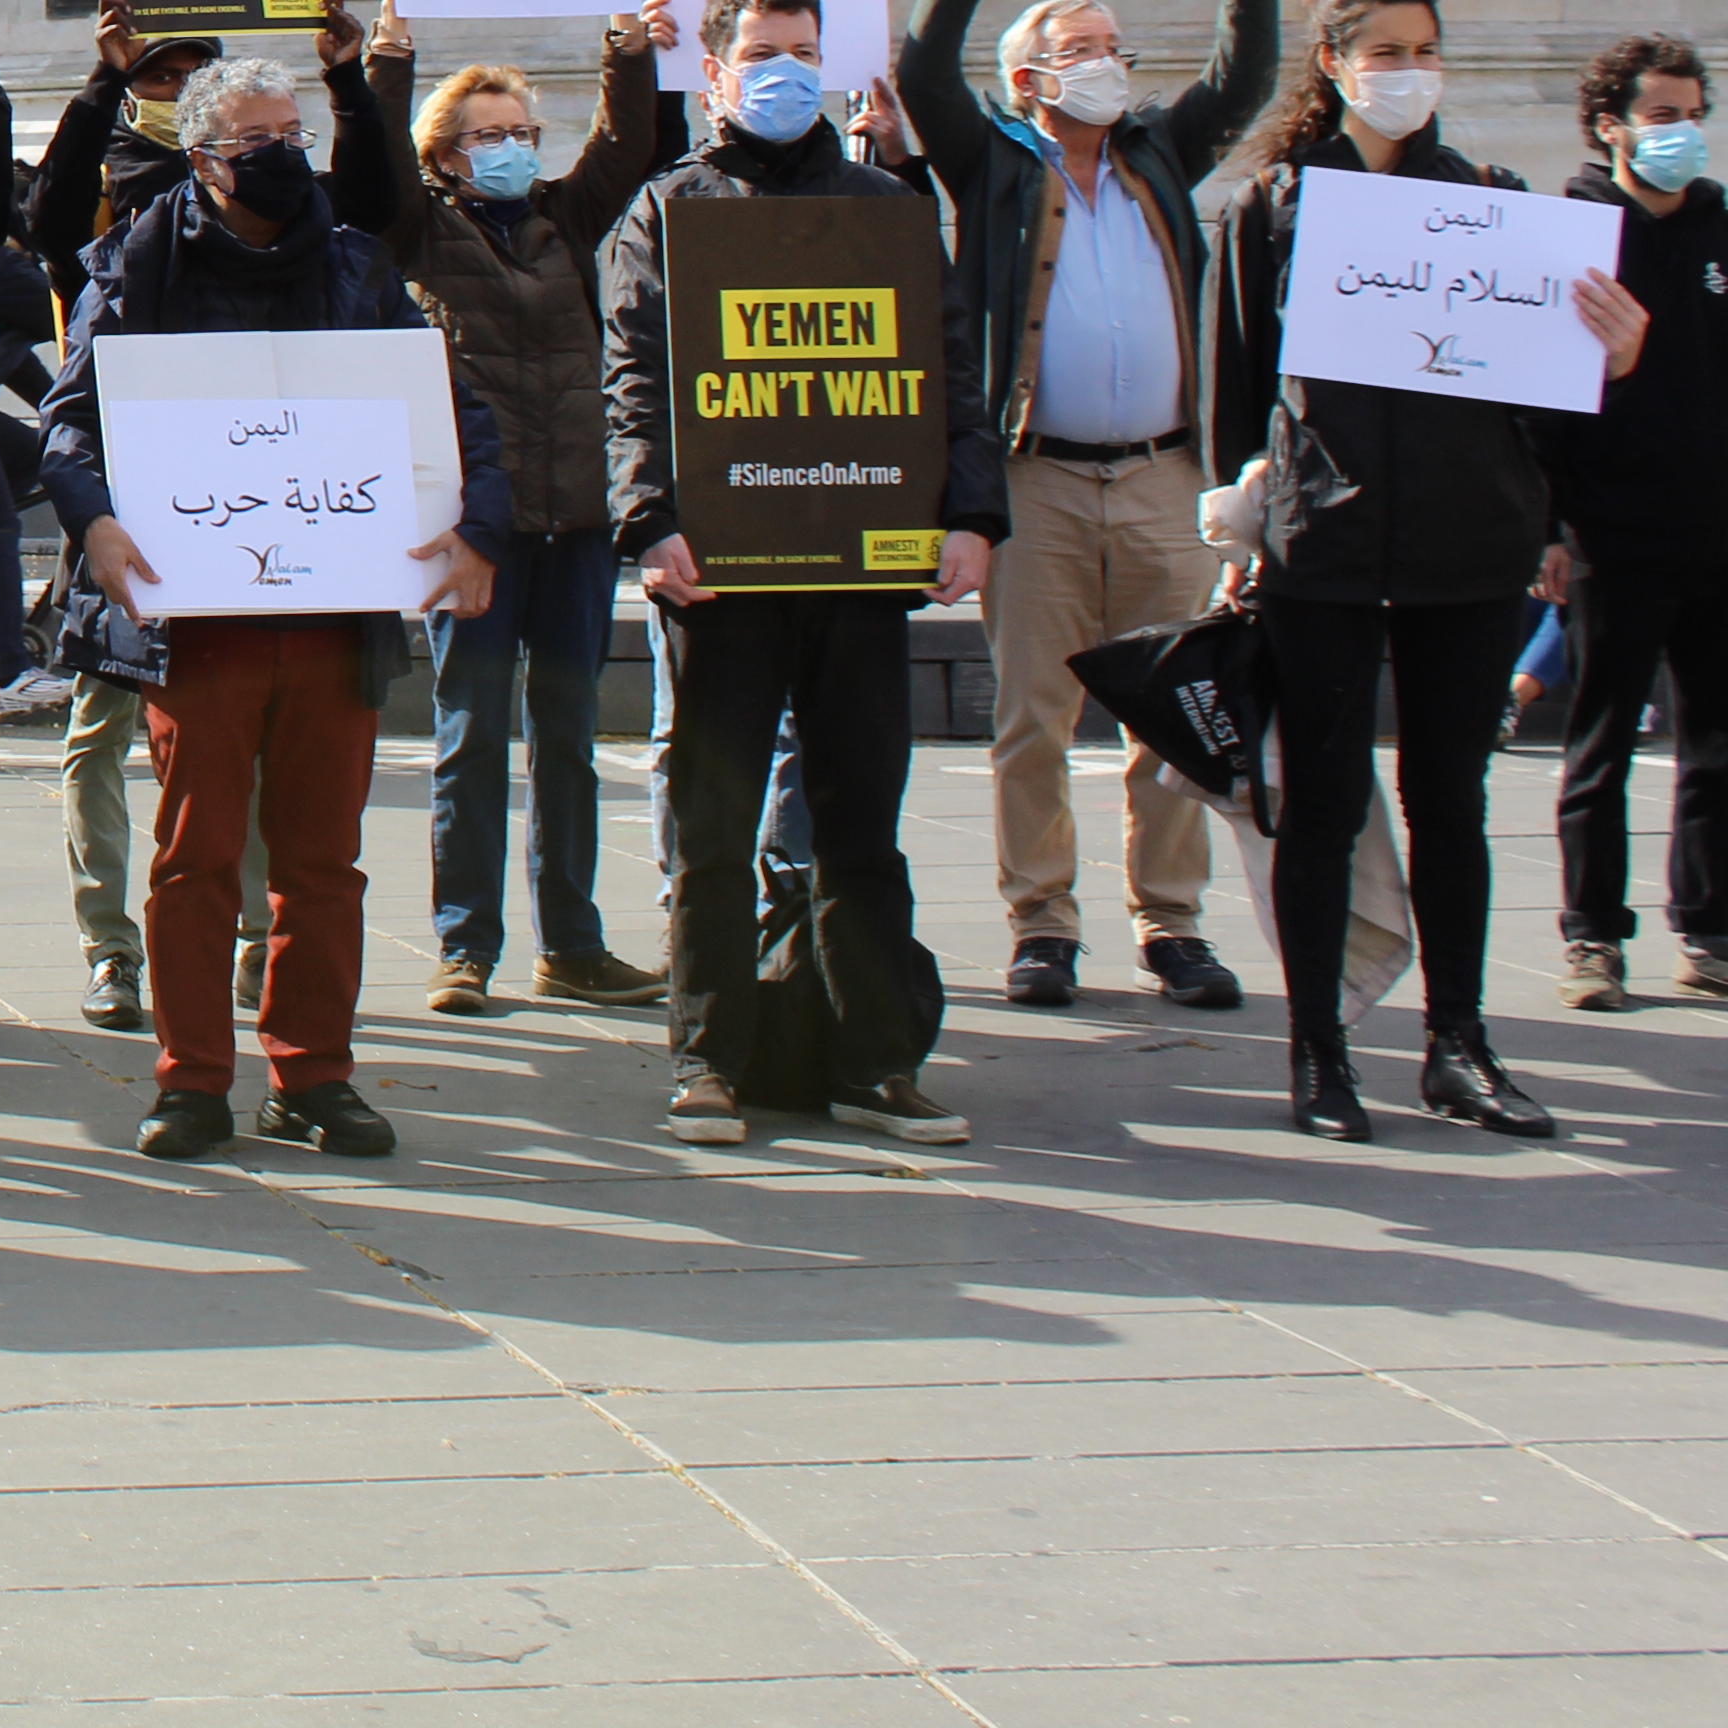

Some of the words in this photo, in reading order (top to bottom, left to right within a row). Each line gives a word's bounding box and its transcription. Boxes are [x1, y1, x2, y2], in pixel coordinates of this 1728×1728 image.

[1425, 204, 1503, 236] اليمن
[1336, 262, 1432, 298] لليمن
[1445, 269, 1559, 312] السلام
[736, 301, 875, 347] YEMEN
[695, 371, 814, 418] CAN'T
[822, 369, 924, 416] WAIT
[228, 410, 298, 446] اليمن
[728, 461, 902, 486] #SilenceOnArme
[172, 494, 269, 527] حرب
[285, 474, 381, 525] كفاية
[872, 539, 919, 552] AMNESTY
